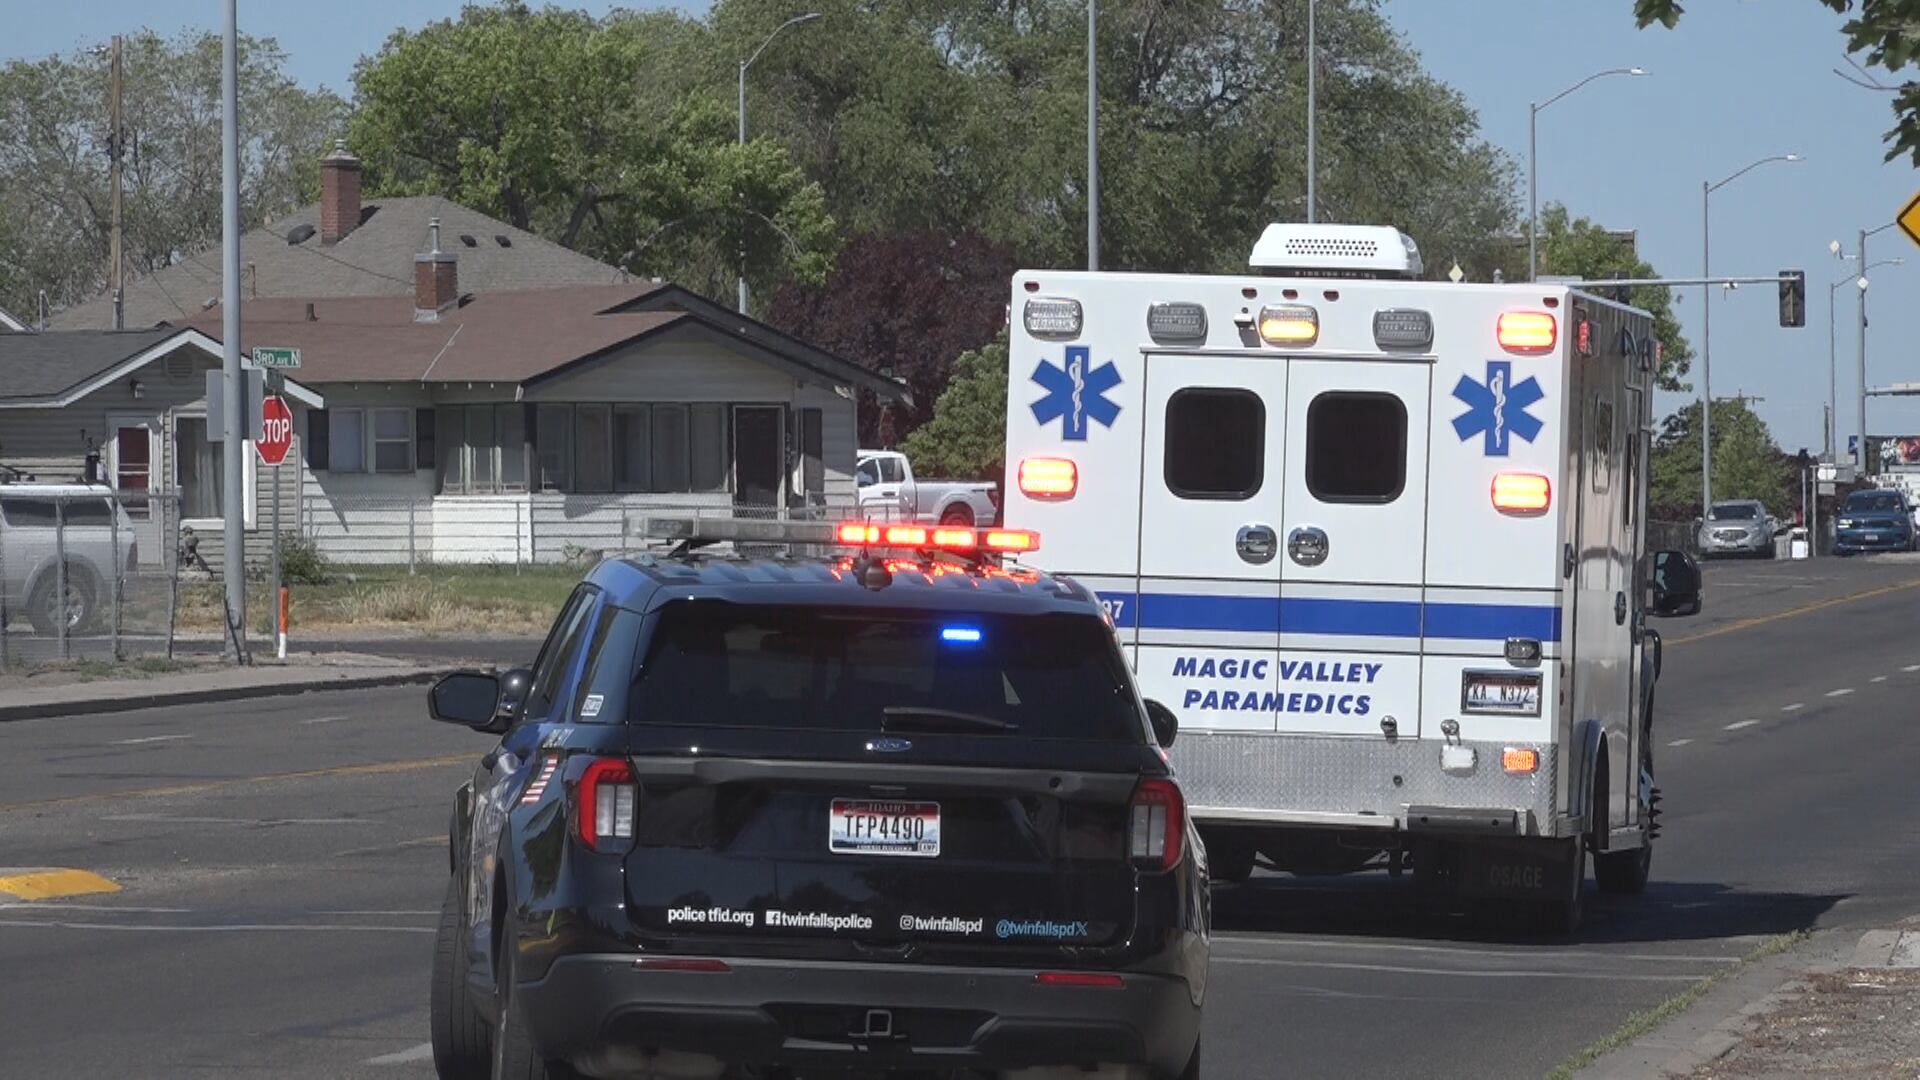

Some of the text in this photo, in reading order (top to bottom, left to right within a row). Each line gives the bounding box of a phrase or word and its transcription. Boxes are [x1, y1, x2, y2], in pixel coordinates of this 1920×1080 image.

[254, 349, 275, 366] 3RD
[290, 350, 299, 366] N
[1172, 657, 1383, 683] MAGIC VALLEY
[1183, 689, 1372, 716] PARAMEDICS
[844, 814, 924, 841] TFP4490
[782, 911, 872, 932] twinfallspolice
[915, 916, 984, 936] twinfallspd
